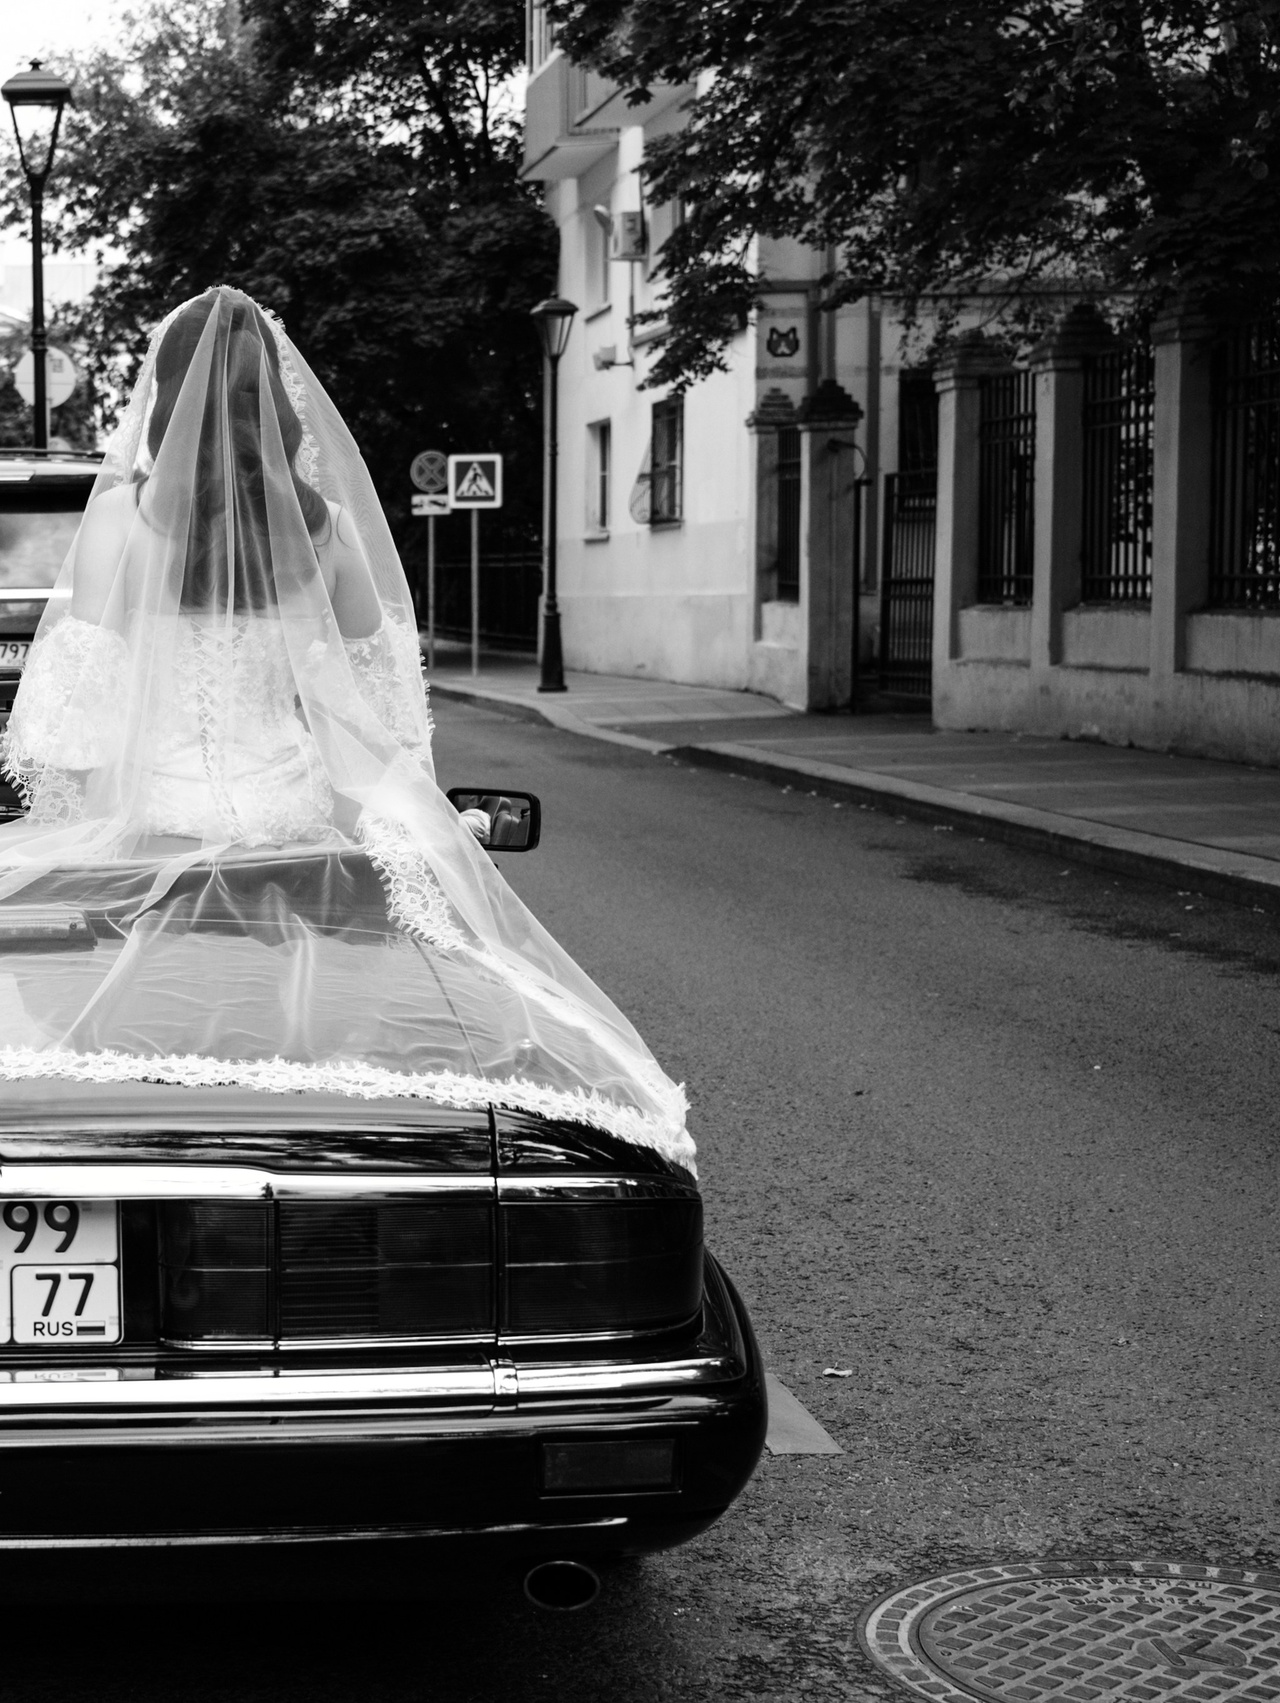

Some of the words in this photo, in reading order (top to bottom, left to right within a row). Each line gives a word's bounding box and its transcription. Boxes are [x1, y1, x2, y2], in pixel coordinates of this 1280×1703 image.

[0, 643, 29, 659] 797
[35, 1273, 94, 1316] 77
[33, 1321, 74, 1336] RUS
